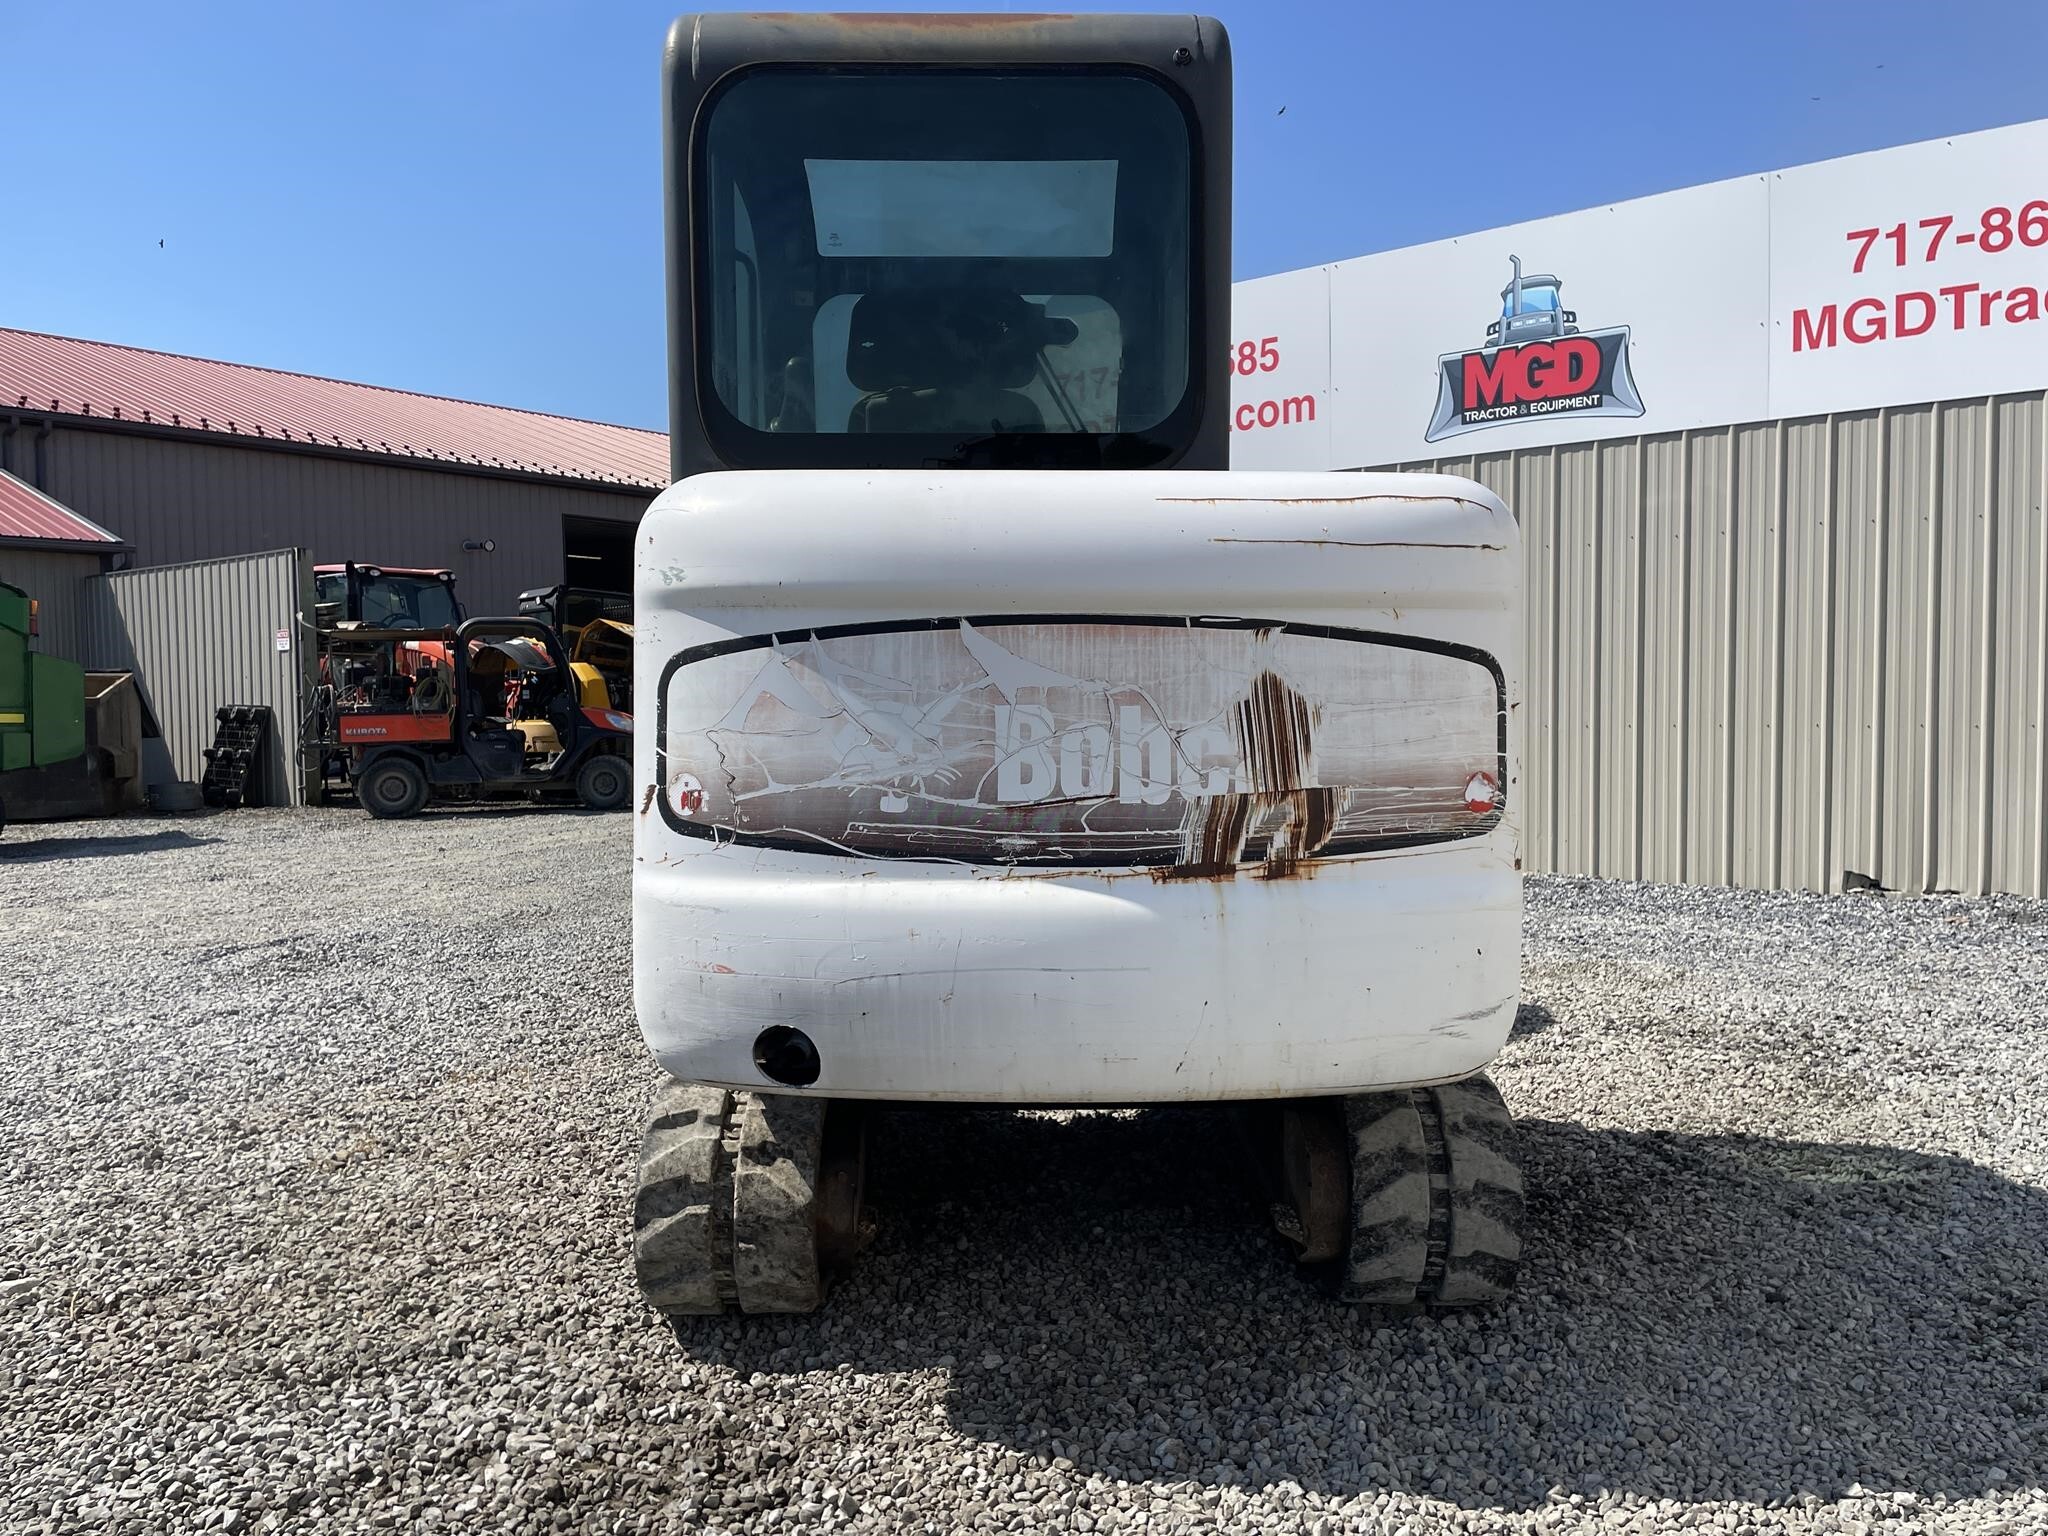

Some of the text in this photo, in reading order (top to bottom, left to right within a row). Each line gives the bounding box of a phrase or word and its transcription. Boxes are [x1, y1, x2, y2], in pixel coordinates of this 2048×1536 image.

[1846, 199, 2048, 274] 717-86
[1792, 282, 2048, 353] MGDTra
[1463, 338, 1601, 409] MGD
[1464, 394, 1600, 422] TRACTOR & EQUIPMENT
[345, 727, 388, 736] KUBOTA
[995, 703, 1318, 804] Bobc
